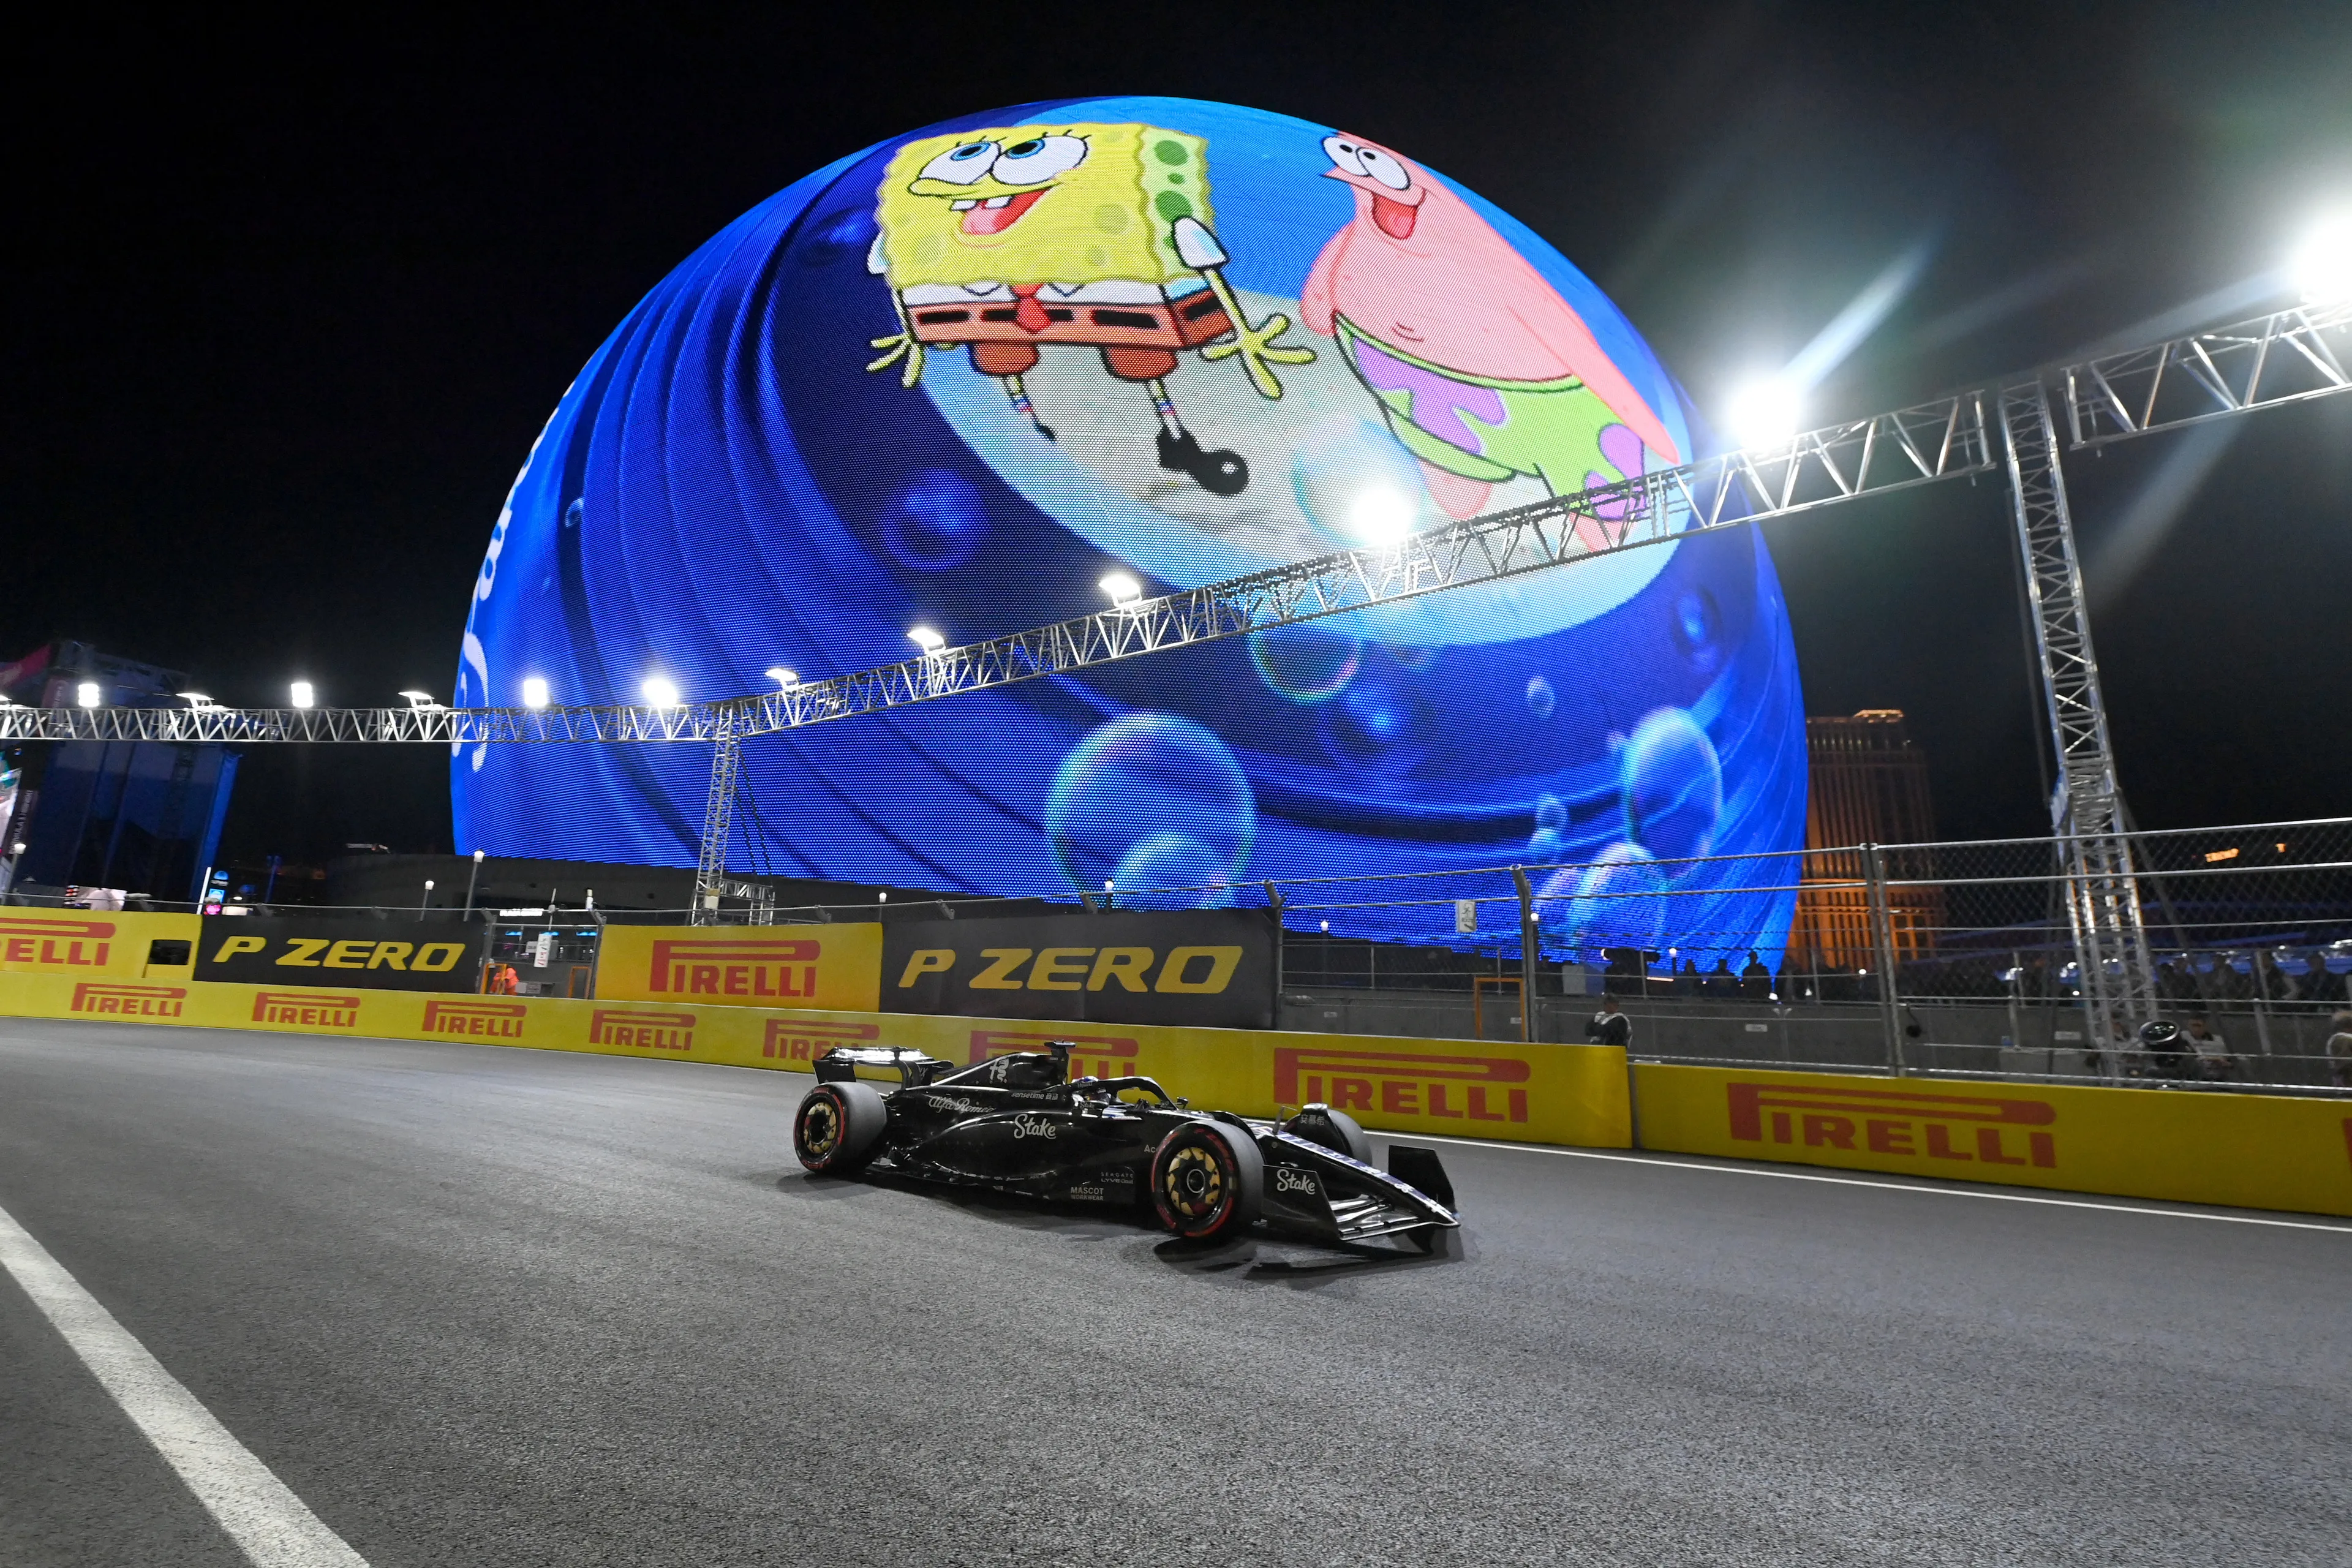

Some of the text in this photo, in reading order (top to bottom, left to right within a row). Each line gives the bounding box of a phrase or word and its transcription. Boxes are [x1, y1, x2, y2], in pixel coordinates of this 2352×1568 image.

[0, 918, 116, 966] ELLI
[213, 936, 466, 971] P ZERO
[649, 940, 821, 997] PIRELLI
[898, 946, 1243, 993] P ZERO
[70, 982, 187, 1017] PIRELLI
[252, 992, 361, 1028] PIRELLI
[422, 1000, 527, 1038] PIRELLI
[589, 1009, 696, 1051] PIRELLI
[763, 1019, 880, 1061] PIRE
[924, 1095, 995, 1113] Alfa Romeo
[1273, 1047, 1530, 1122] PIRELLI
[1014, 1114, 1056, 1139] Stake
[1727, 1082, 2057, 1168] PIRELLI
[1276, 1169, 1316, 1195] Stake
